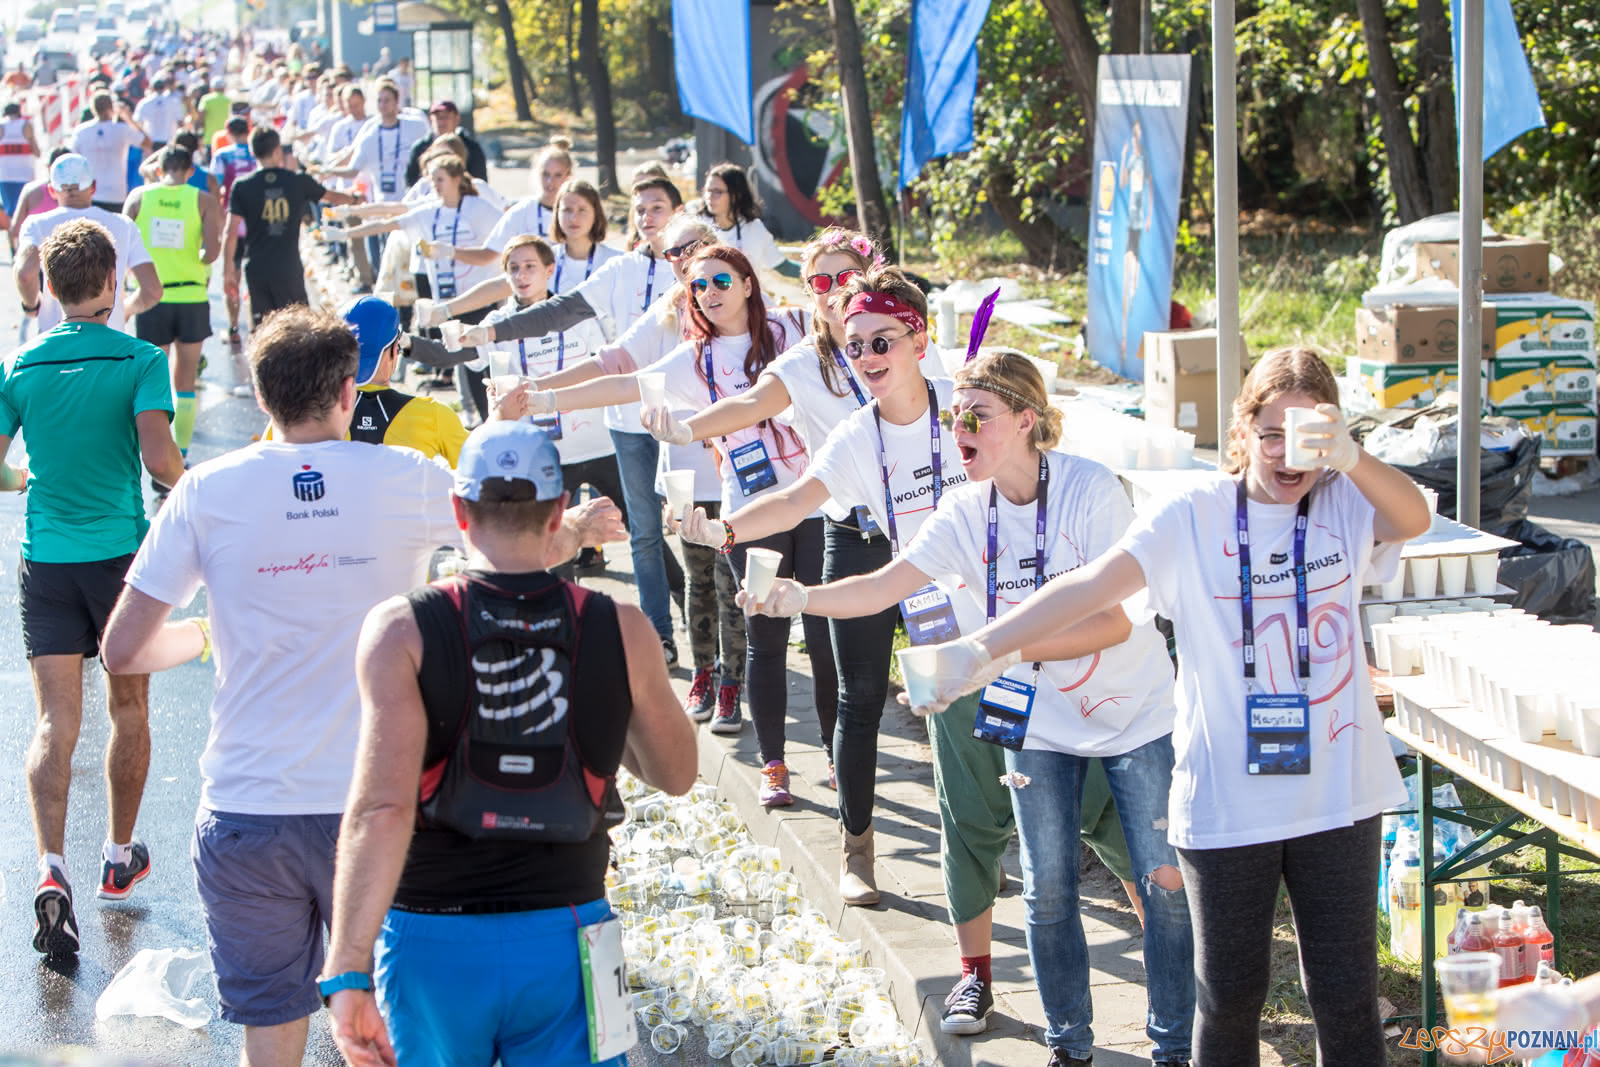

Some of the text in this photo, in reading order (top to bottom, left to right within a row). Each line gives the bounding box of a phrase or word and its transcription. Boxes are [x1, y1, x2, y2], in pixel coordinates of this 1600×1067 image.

[262, 197, 289, 224] 40
[893, 473, 967, 505] WOLONARIU
[286, 507, 339, 521] Bank Polski
[988, 561, 997, 595] 14.10.2018
[909, 593, 942, 609] KAMIL
